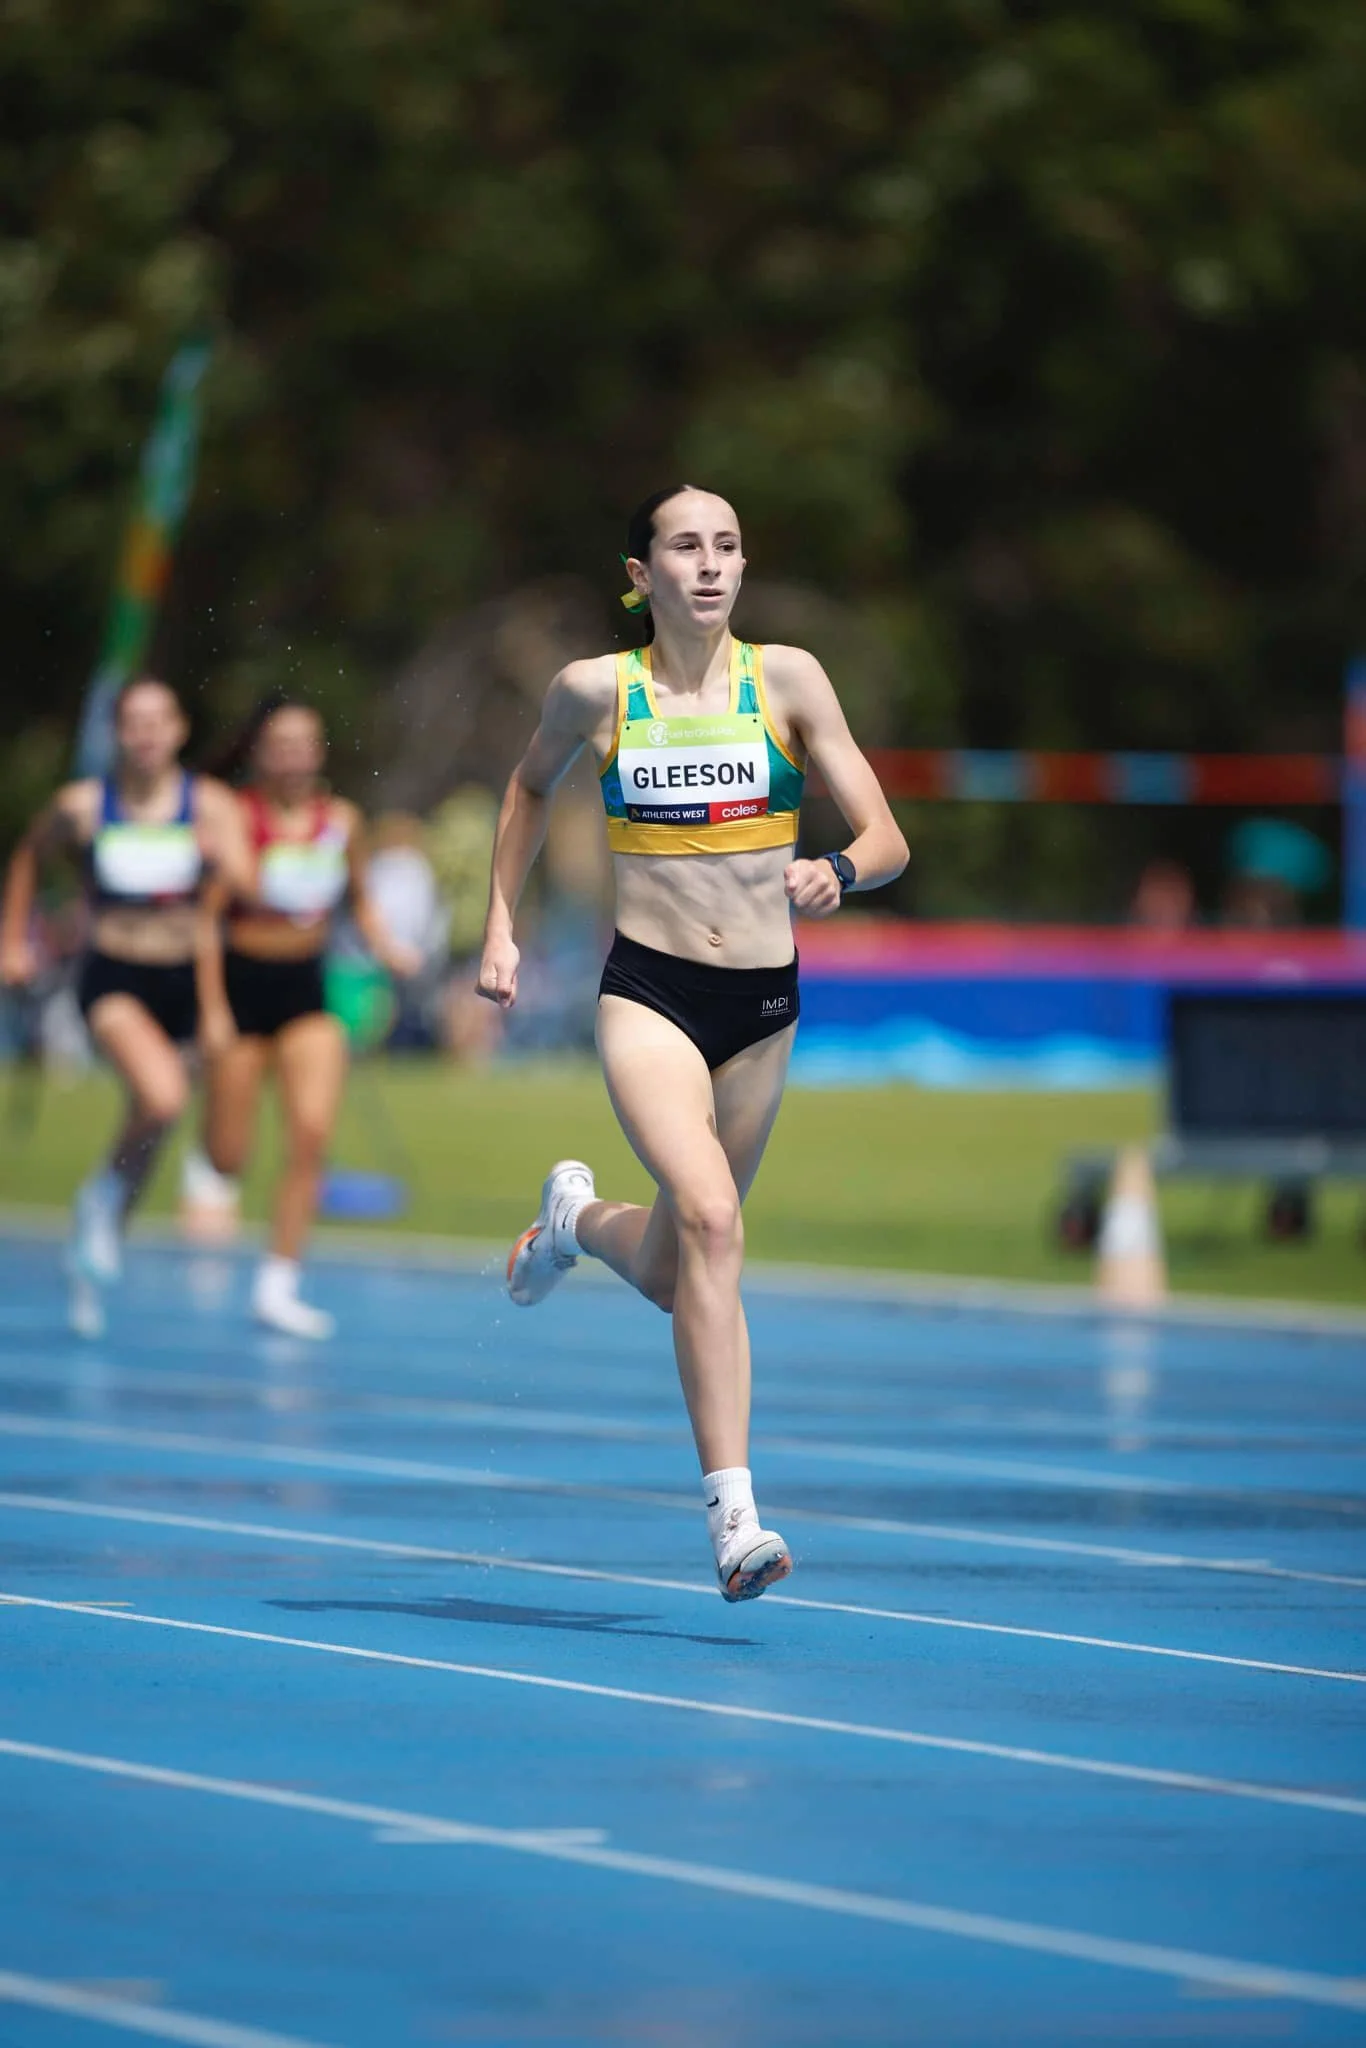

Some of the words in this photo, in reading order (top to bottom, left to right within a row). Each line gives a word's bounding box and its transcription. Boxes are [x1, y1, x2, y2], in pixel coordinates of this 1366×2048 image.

[633, 761, 755, 789] GLEESON
[642, 810, 681, 819] ATHLETICS
[682, 809, 706, 819] WEST
[721, 804, 758, 818] coles
